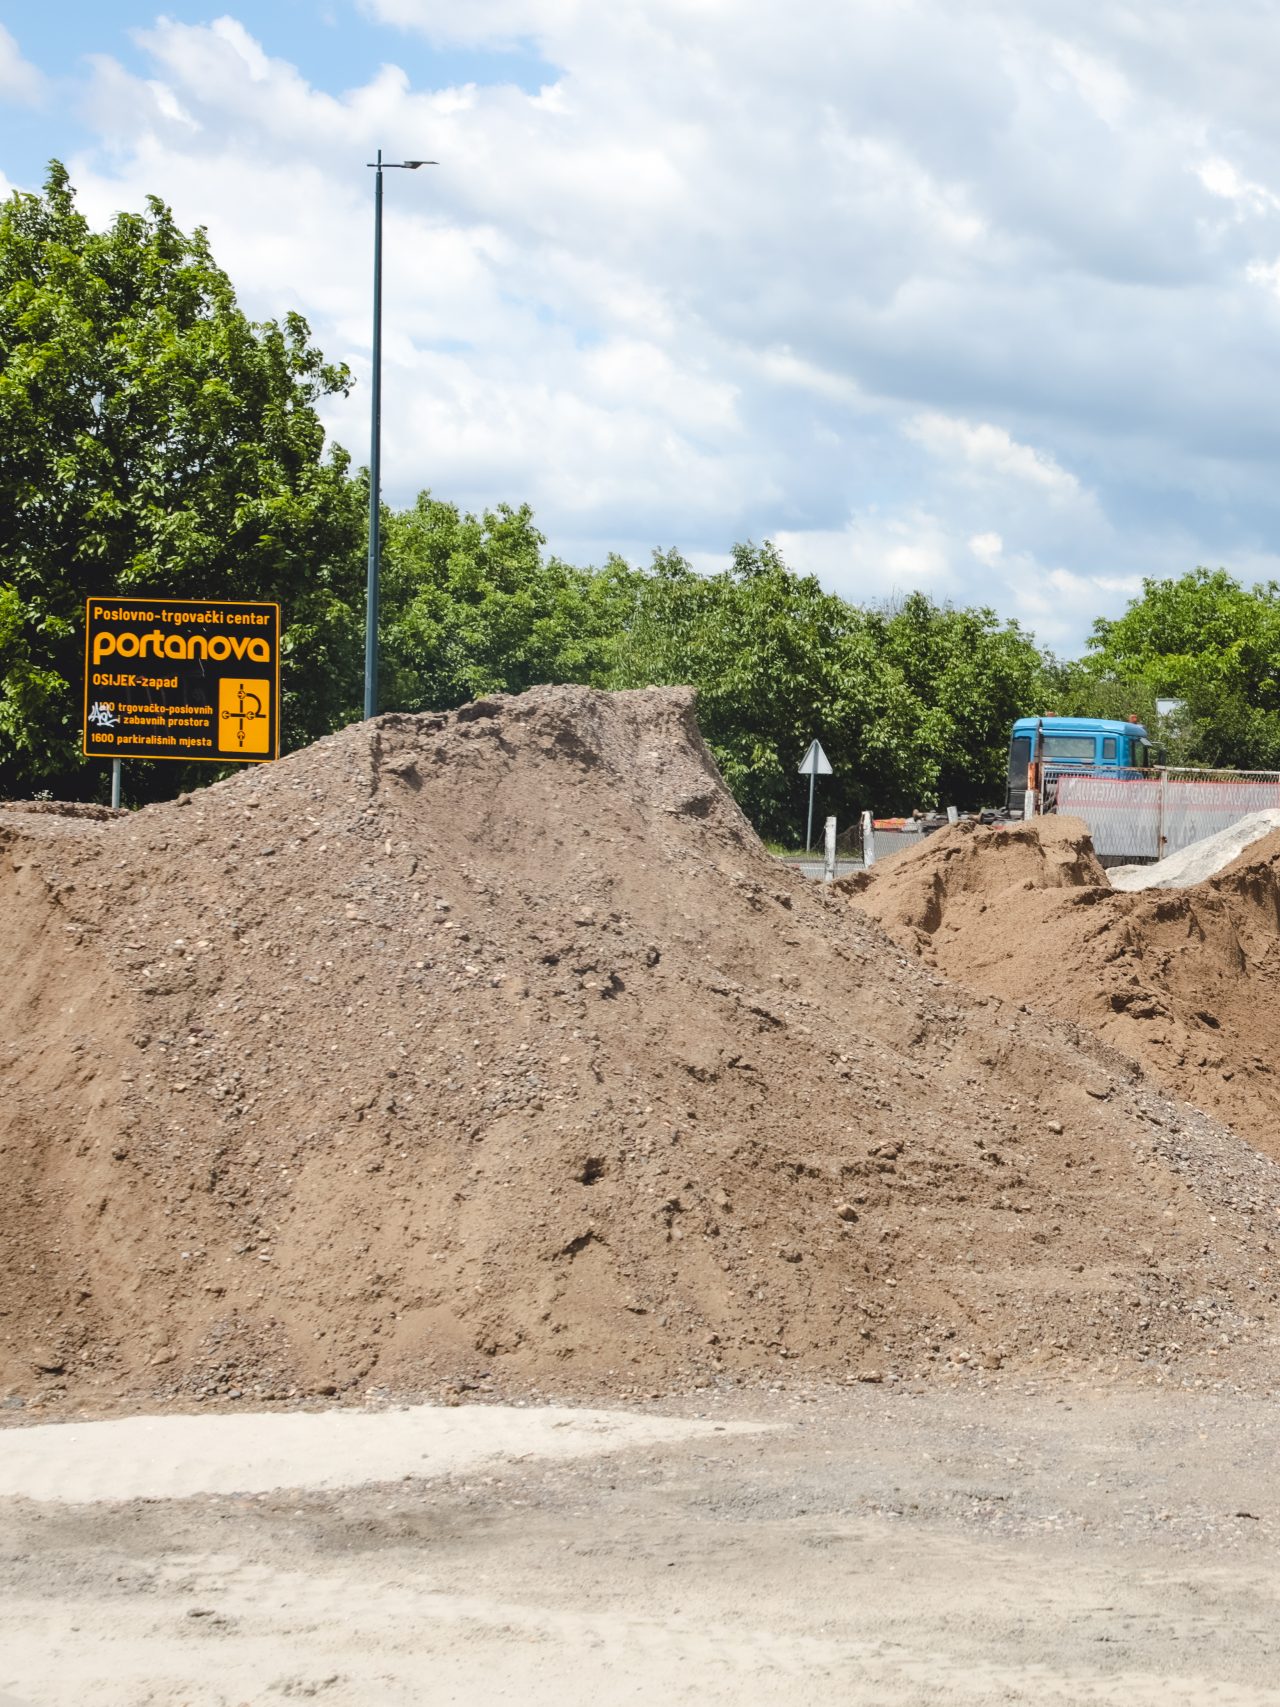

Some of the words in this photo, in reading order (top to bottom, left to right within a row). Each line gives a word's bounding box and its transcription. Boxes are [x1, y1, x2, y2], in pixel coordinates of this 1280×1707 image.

[94, 607, 223, 625] Poslovno-trgovački
[226, 612, 270, 625] centar
[93, 630, 270, 665] portanova
[93, 674, 178, 690] OSIJEK-zapad
[118, 703, 213, 717] trgovačko-poslovnih
[123, 716, 165, 726] zabavnih
[168, 718, 210, 727] prostora
[91, 733, 114, 743] 1600
[117, 734, 177, 745] parkirališnih
[179, 737, 213, 748] mjesta
